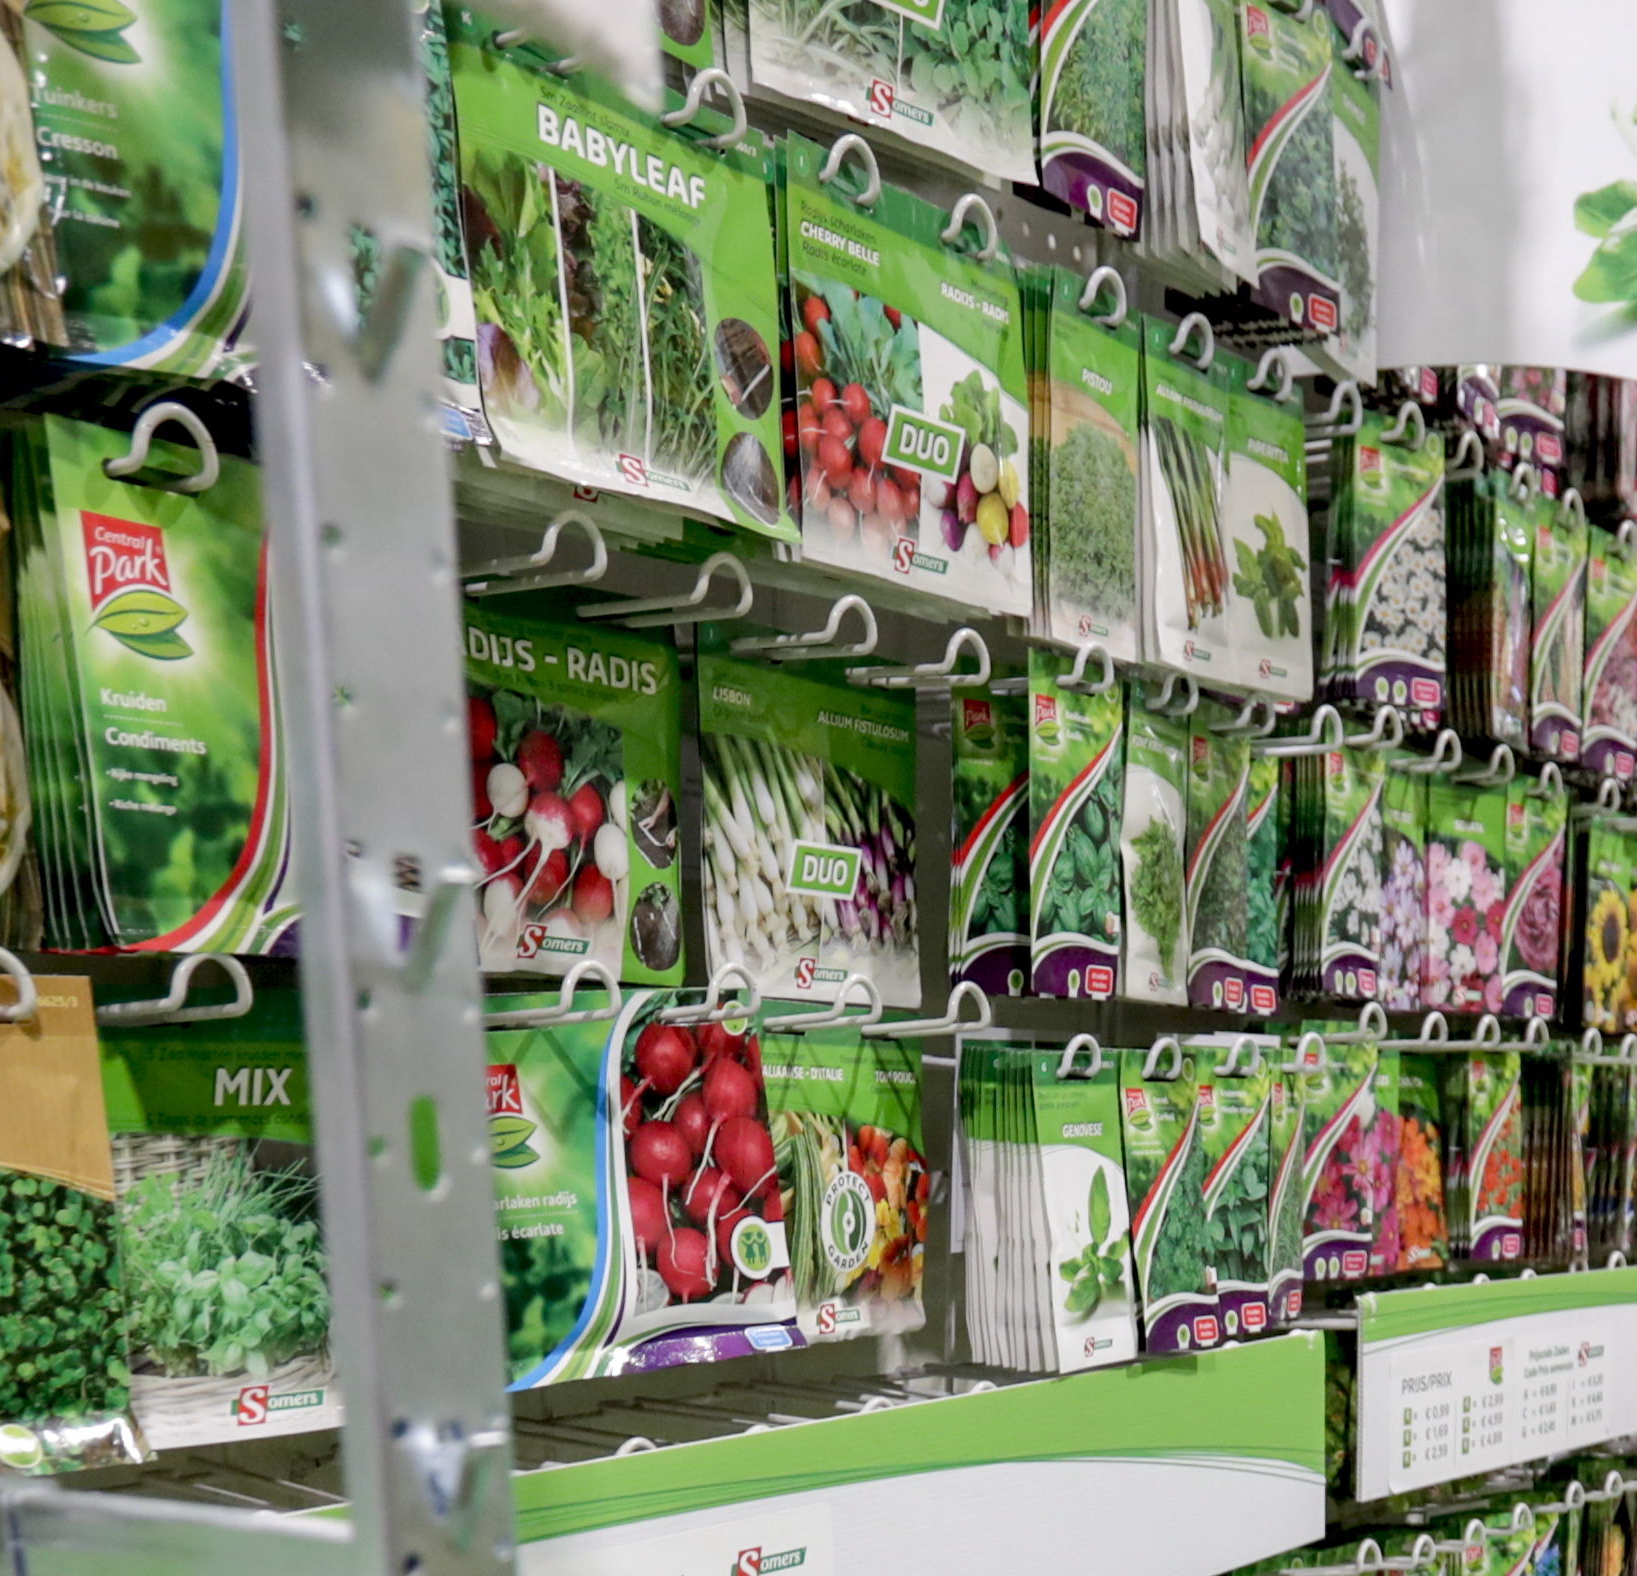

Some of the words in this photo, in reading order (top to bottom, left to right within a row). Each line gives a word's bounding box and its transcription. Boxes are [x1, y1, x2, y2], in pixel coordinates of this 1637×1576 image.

[869, 77, 934, 127] Somers
[37, 126, 118, 160] Cresson
[537, 103, 706, 209] BABYLEAF
[801, 221, 846, 250] CHERRY
[848, 242, 880, 267] BELLE
[899, 425, 951, 466] DUO
[616, 452, 691, 492] Somers
[94, 526, 145, 550] Central
[89, 538, 168, 595] Park
[893, 536, 948, 575] Somers
[462, 625, 537, 673] DIJS
[566, 646, 658, 696] RADIS
[100, 687, 167, 713] Kruiden
[713, 685, 752, 708] LISBON
[817, 710, 853, 730] ALLIUM
[105, 726, 207, 755] Condiments
[799, 854, 850, 887] DUO
[516, 922, 589, 960] Somers
[796, 957, 848, 989] Somers
[214, 1067, 293, 1107] MIX
[1062, 1122, 1103, 1139] GENOVESE
[826, 1174, 871, 1207] PROTECT
[511, 1221, 564, 1240] écarlate
[827, 1241, 870, 1271] GARDEN
[1401, 1370, 1453, 1395] PRIJS/PRIX
[231, 1386, 324, 1426] Somers
